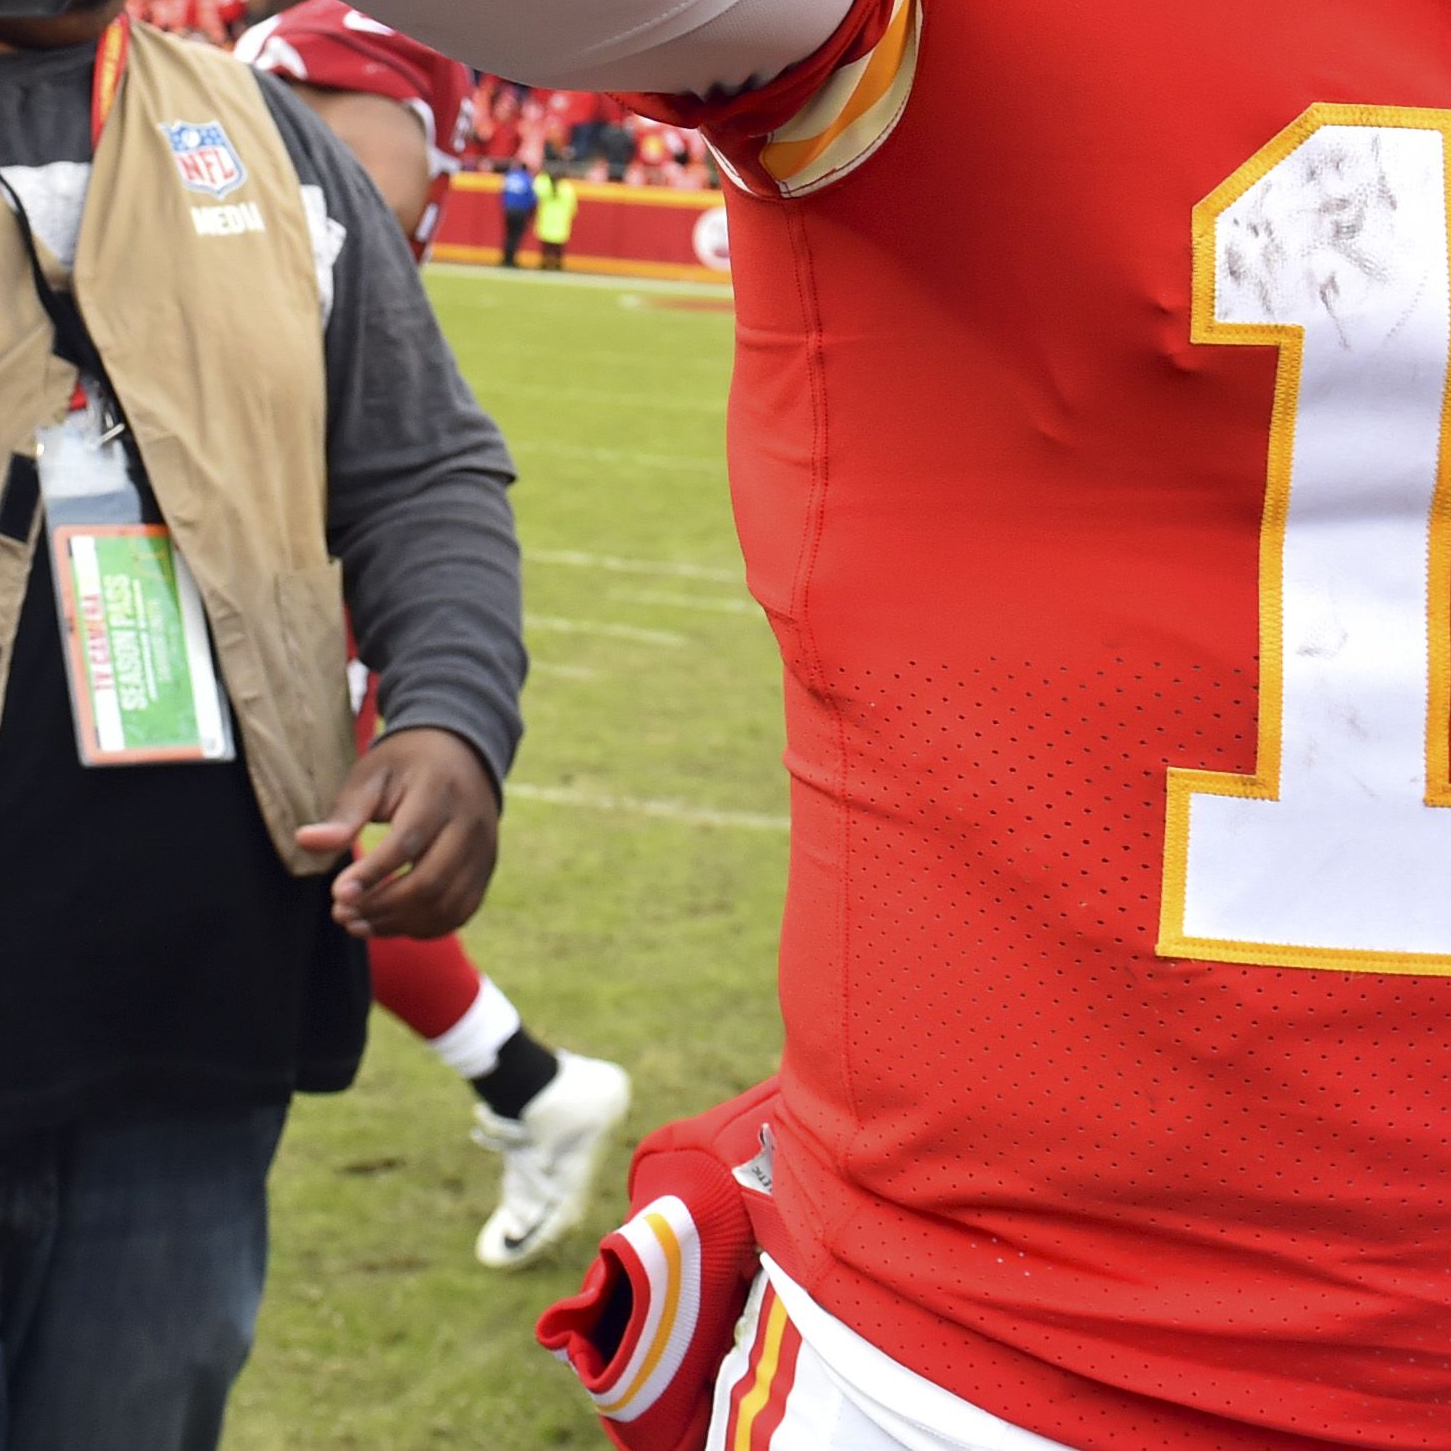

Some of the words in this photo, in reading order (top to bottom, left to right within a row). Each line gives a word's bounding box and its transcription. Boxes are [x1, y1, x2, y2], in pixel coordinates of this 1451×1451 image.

[178, 148, 235, 186] NFL
[190, 202, 266, 236] MEDIA
[103, 573, 136, 627] PASS
[111, 628, 147, 711] SEASON
